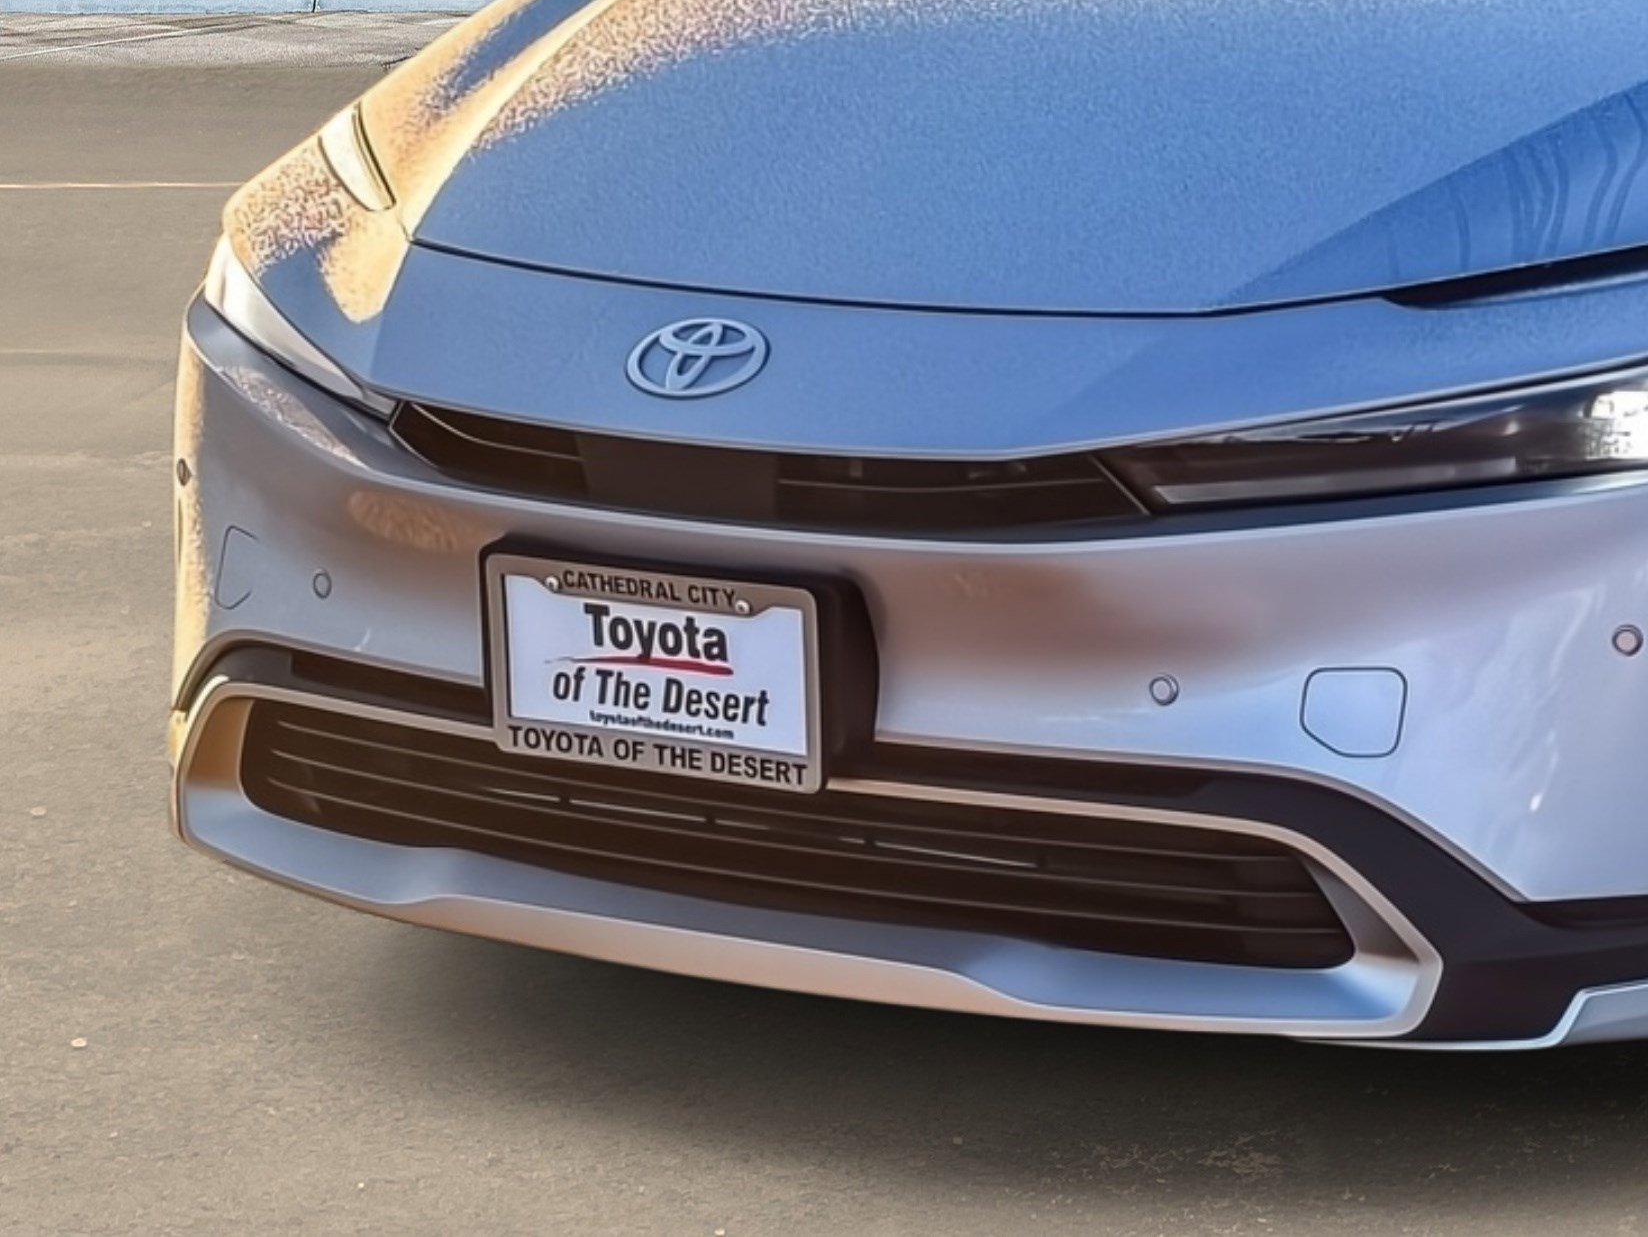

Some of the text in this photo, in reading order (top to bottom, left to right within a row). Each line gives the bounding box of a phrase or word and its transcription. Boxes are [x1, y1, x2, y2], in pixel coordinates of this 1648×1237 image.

[562, 570, 736, 607] CATHEDRAL CITY
[583, 602, 728, 662] Toyota
[553, 666, 770, 727] of The Desert
[589, 710, 735, 740] toyotaofthedesert.com
[508, 725, 809, 786] TOYOTA OF THE DESERT
